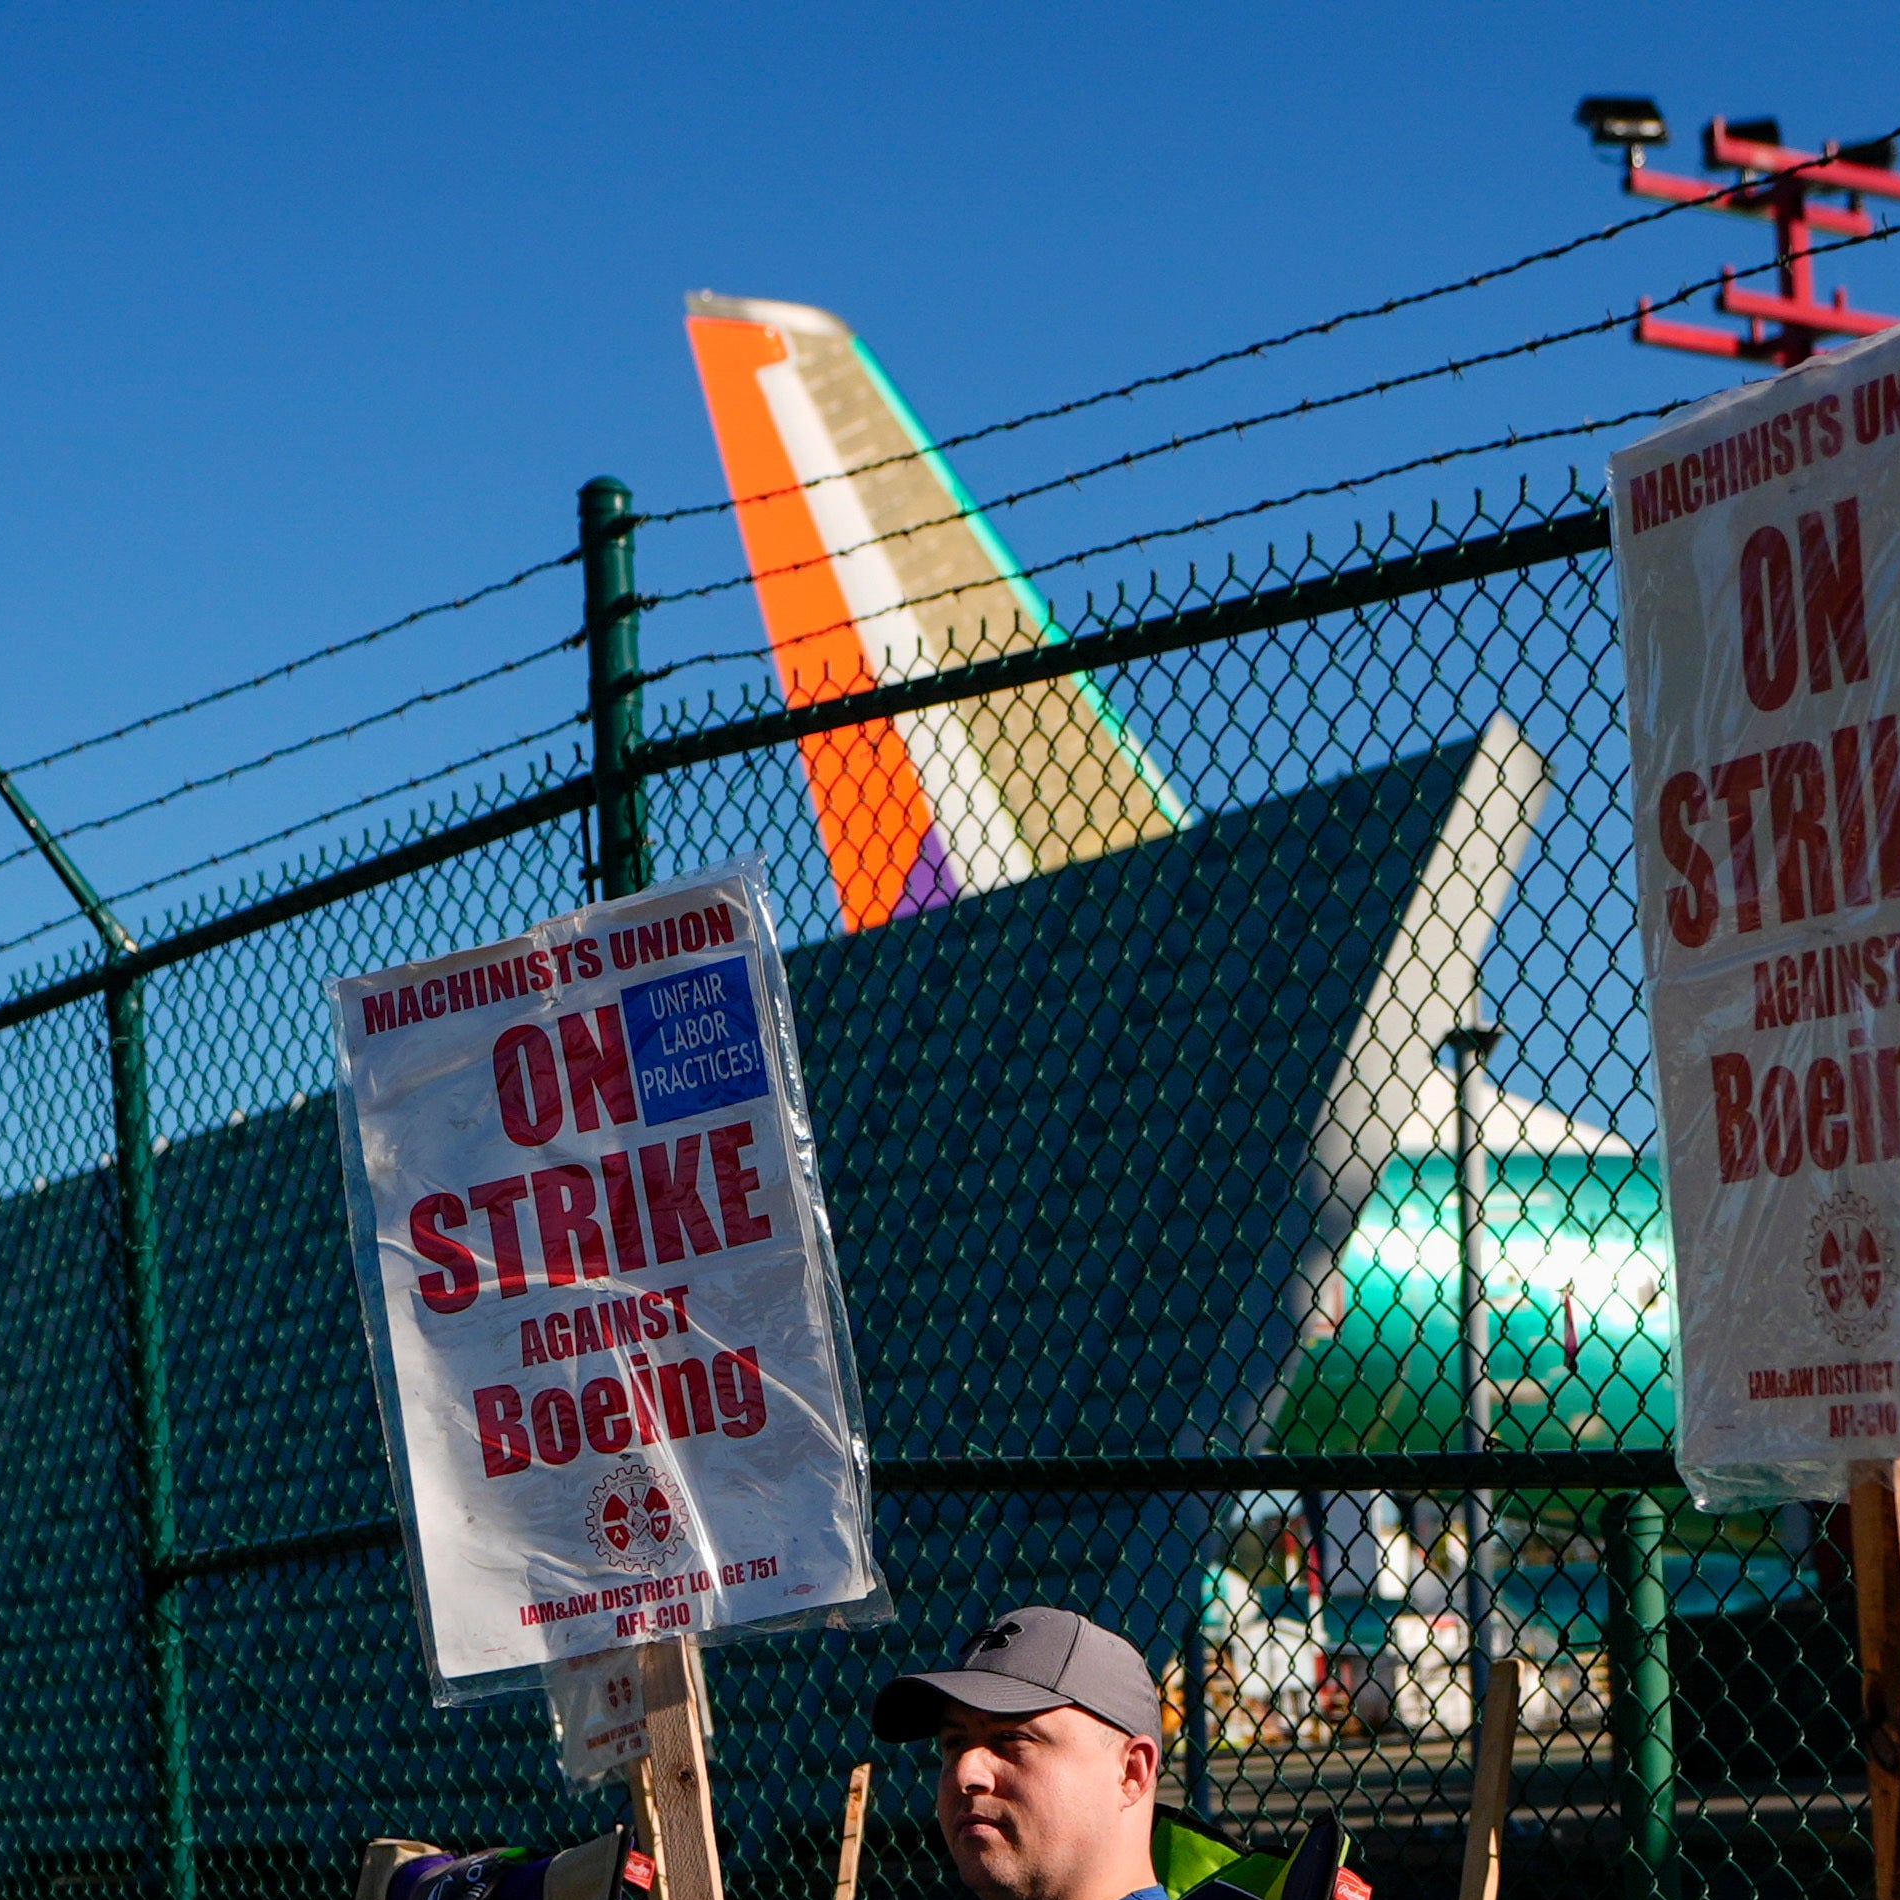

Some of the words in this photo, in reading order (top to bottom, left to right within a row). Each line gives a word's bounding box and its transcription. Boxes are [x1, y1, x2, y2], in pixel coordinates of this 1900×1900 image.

[1629, 391, 1844, 535] MACHINISTS
[1738, 496, 1870, 712] ON
[362, 937, 602, 1036] MACHINISTS
[609, 903, 735, 971] UNION
[649, 972, 727, 1020] UNFAIR
[641, 1041, 761, 1101] PRACTICES!
[659, 1014, 731, 1057] LABOR
[492, 1003, 639, 1147] ON
[409, 1121, 772, 1315] STRIKE
[520, 1286, 690, 1368] AGAINST
[472, 1345, 767, 1479] Boeing
[1818, 1361, 1894, 1396] DISTRICT
[1829, 1402, 1898, 1438] AFL-CIO
[519, 1592, 597, 1627] IAM&AW
[602, 1575, 686, 1610] DISTRICT
[690, 1562, 746, 1594] LOGE
[748, 1555, 779, 1582] 751
[616, 1602, 692, 1638] AFL-CIO
